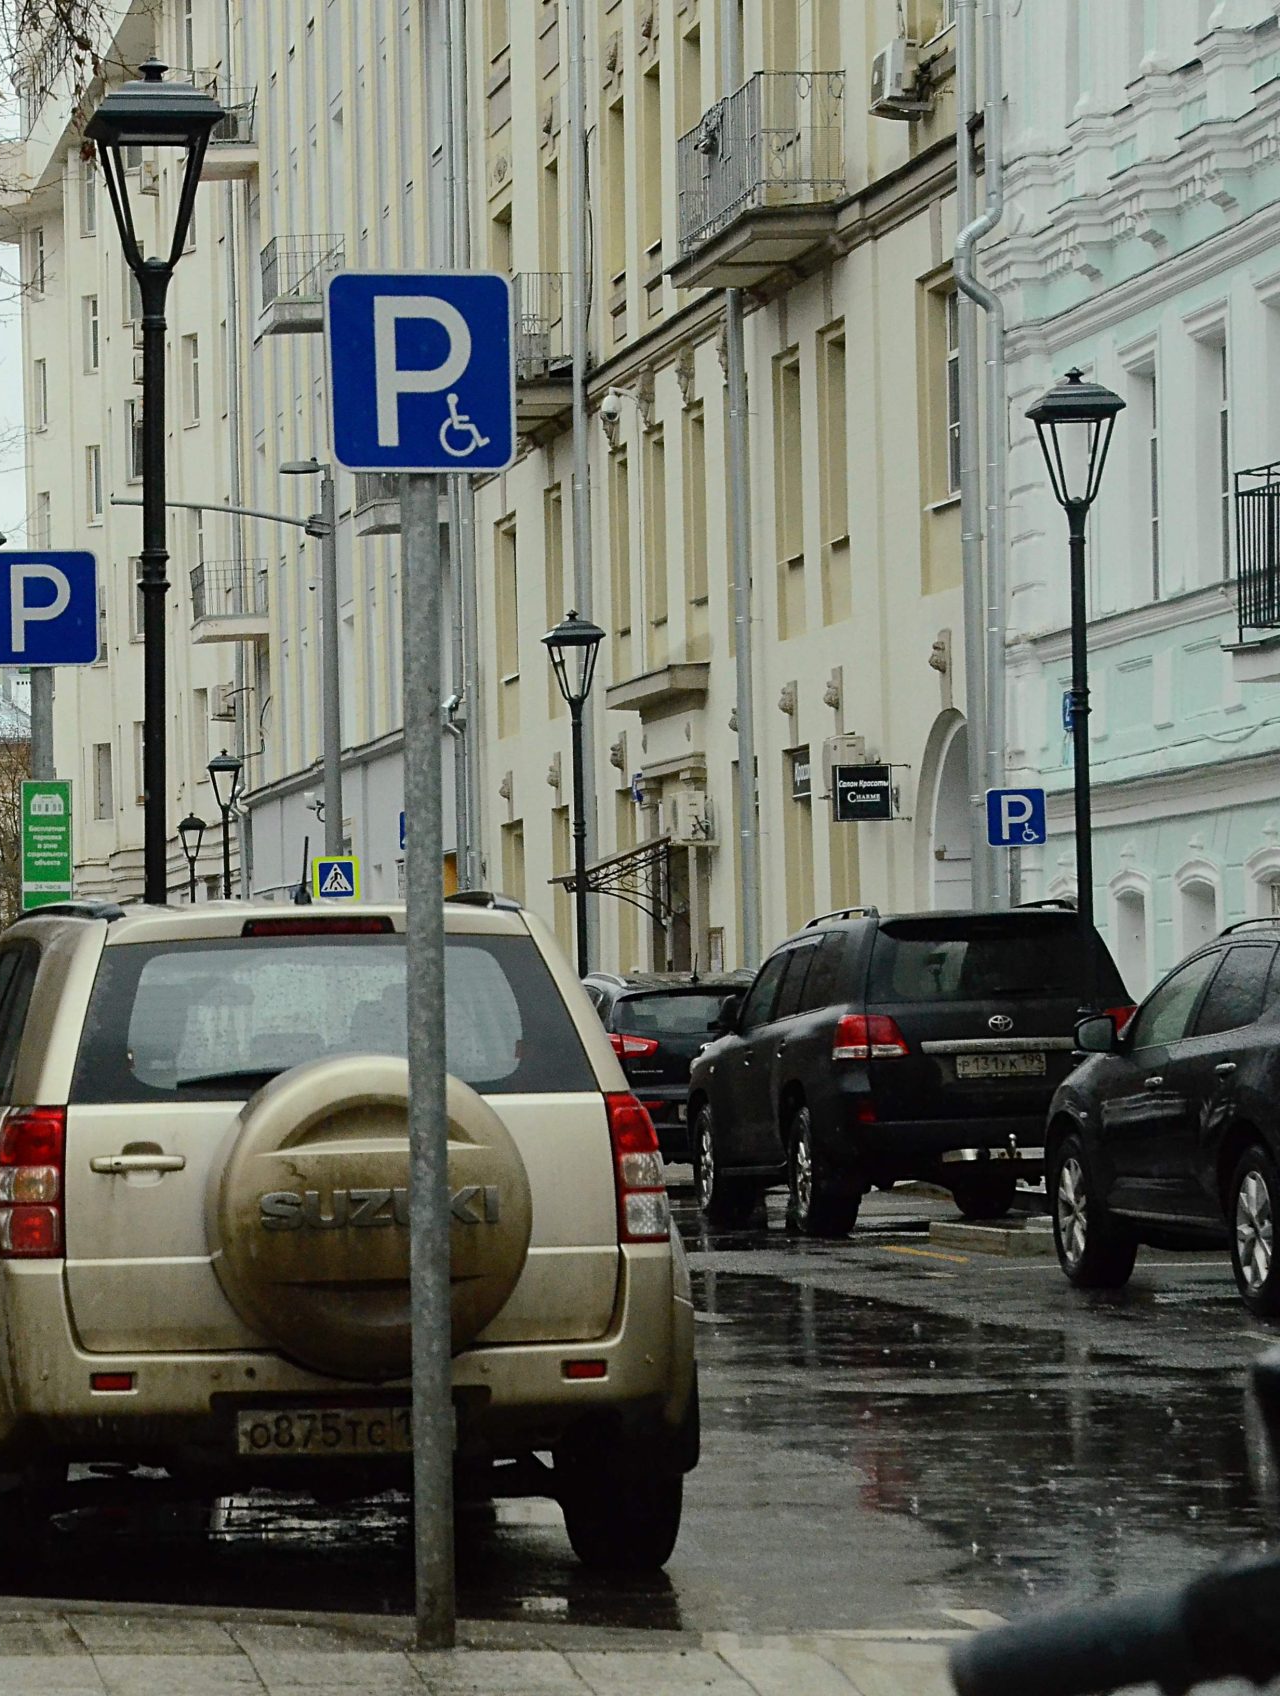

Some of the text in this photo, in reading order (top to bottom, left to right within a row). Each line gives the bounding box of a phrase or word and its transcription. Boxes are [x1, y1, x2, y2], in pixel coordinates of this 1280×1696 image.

[374, 295, 472, 447] P
[10, 564, 71, 652] P
[839, 779, 889, 788] Салон Красоты
[1001, 795, 1033, 839] P
